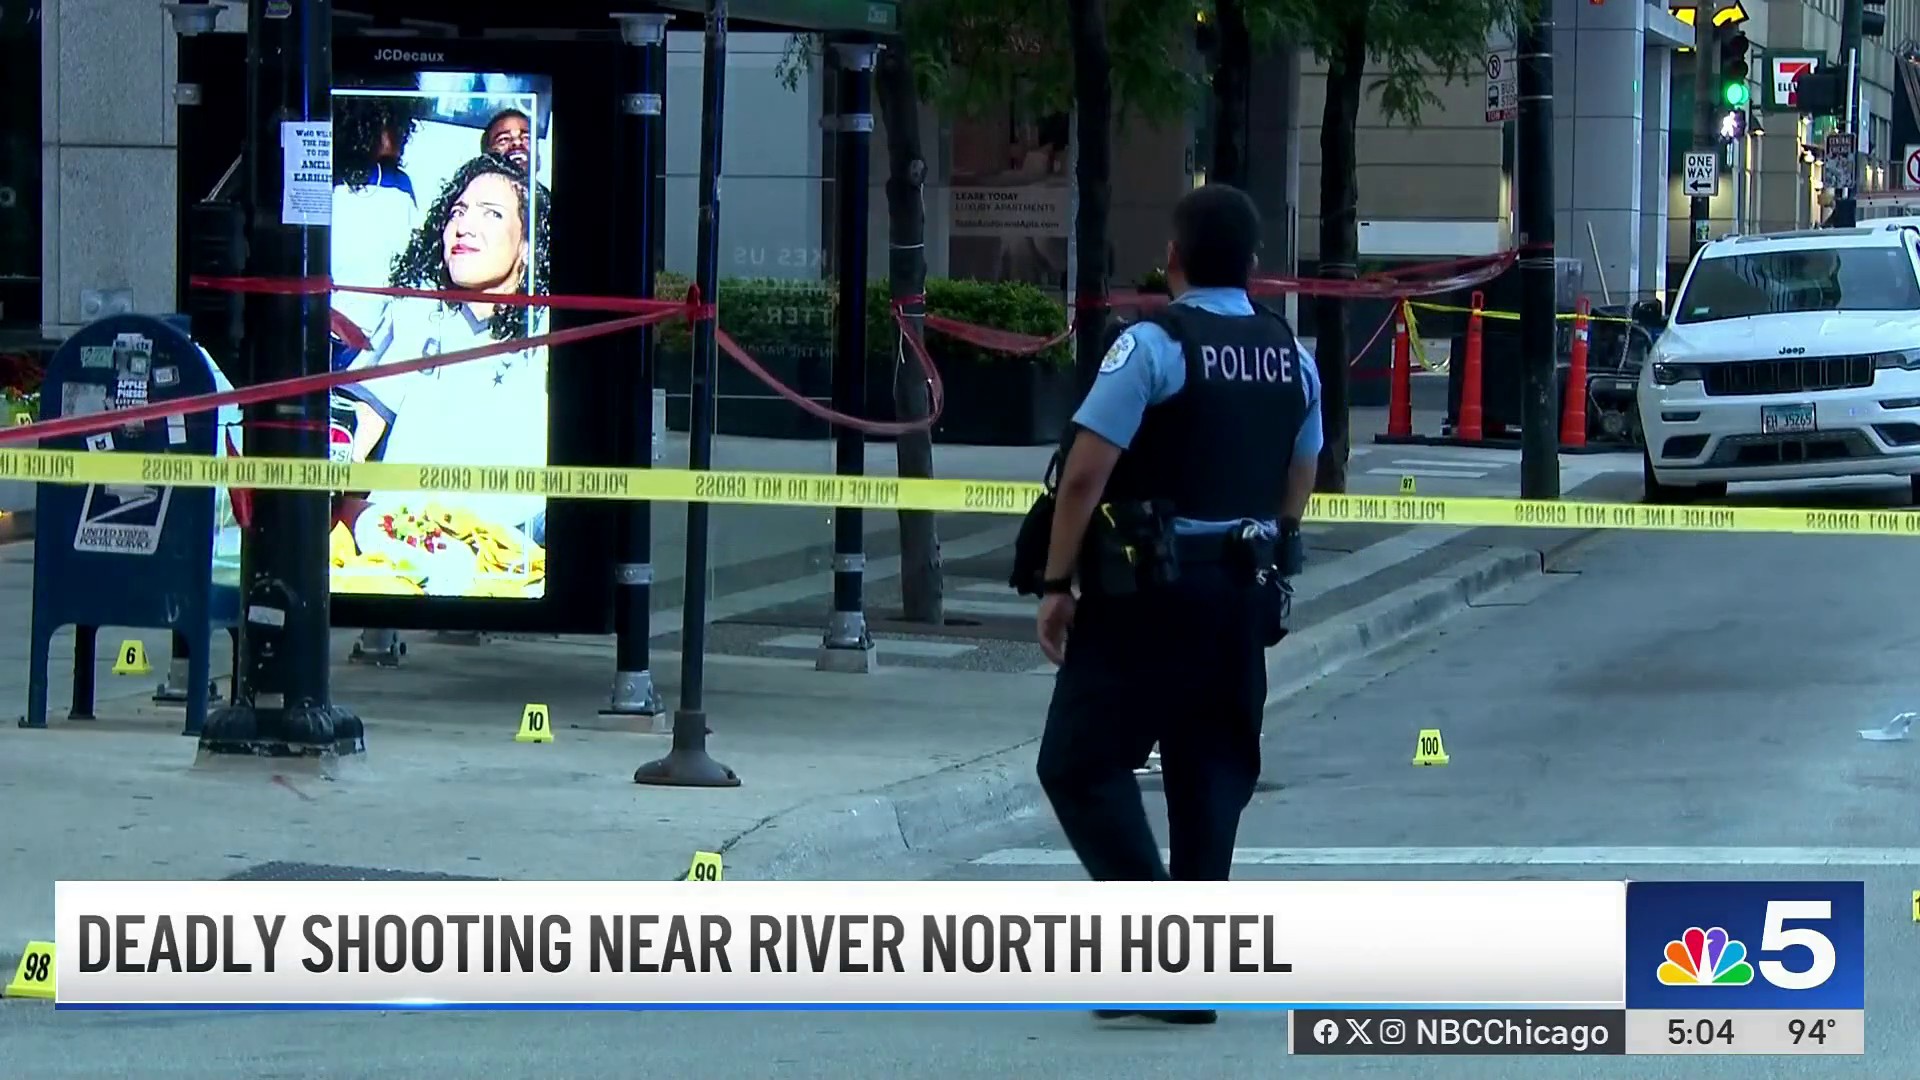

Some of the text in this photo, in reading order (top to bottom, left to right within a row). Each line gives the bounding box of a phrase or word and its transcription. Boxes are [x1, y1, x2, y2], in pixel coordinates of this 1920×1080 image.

[374, 48, 445, 62] JCDecaux
[1778, 82, 1799, 93] ELEV
[1779, 62, 1812, 105] 7
[1688, 156, 1712, 167] ONE
[1687, 168, 1712, 178] WAY
[955, 192, 1018, 201] LEASE TODAY
[1778, 346, 1806, 356] Jeep
[1200, 345, 1293, 383] POLICE
[1402, 478, 1413, 490] 97
[82, 527, 149, 539] UNITED STATES
[79, 536, 151, 550] POSTAL SERVICE
[126, 646, 137, 666] 6
[527, 711, 544, 732] 10
[1420, 736, 1439, 756] 100
[695, 862, 717, 881] 99
[24, 951, 51, 982] 98
